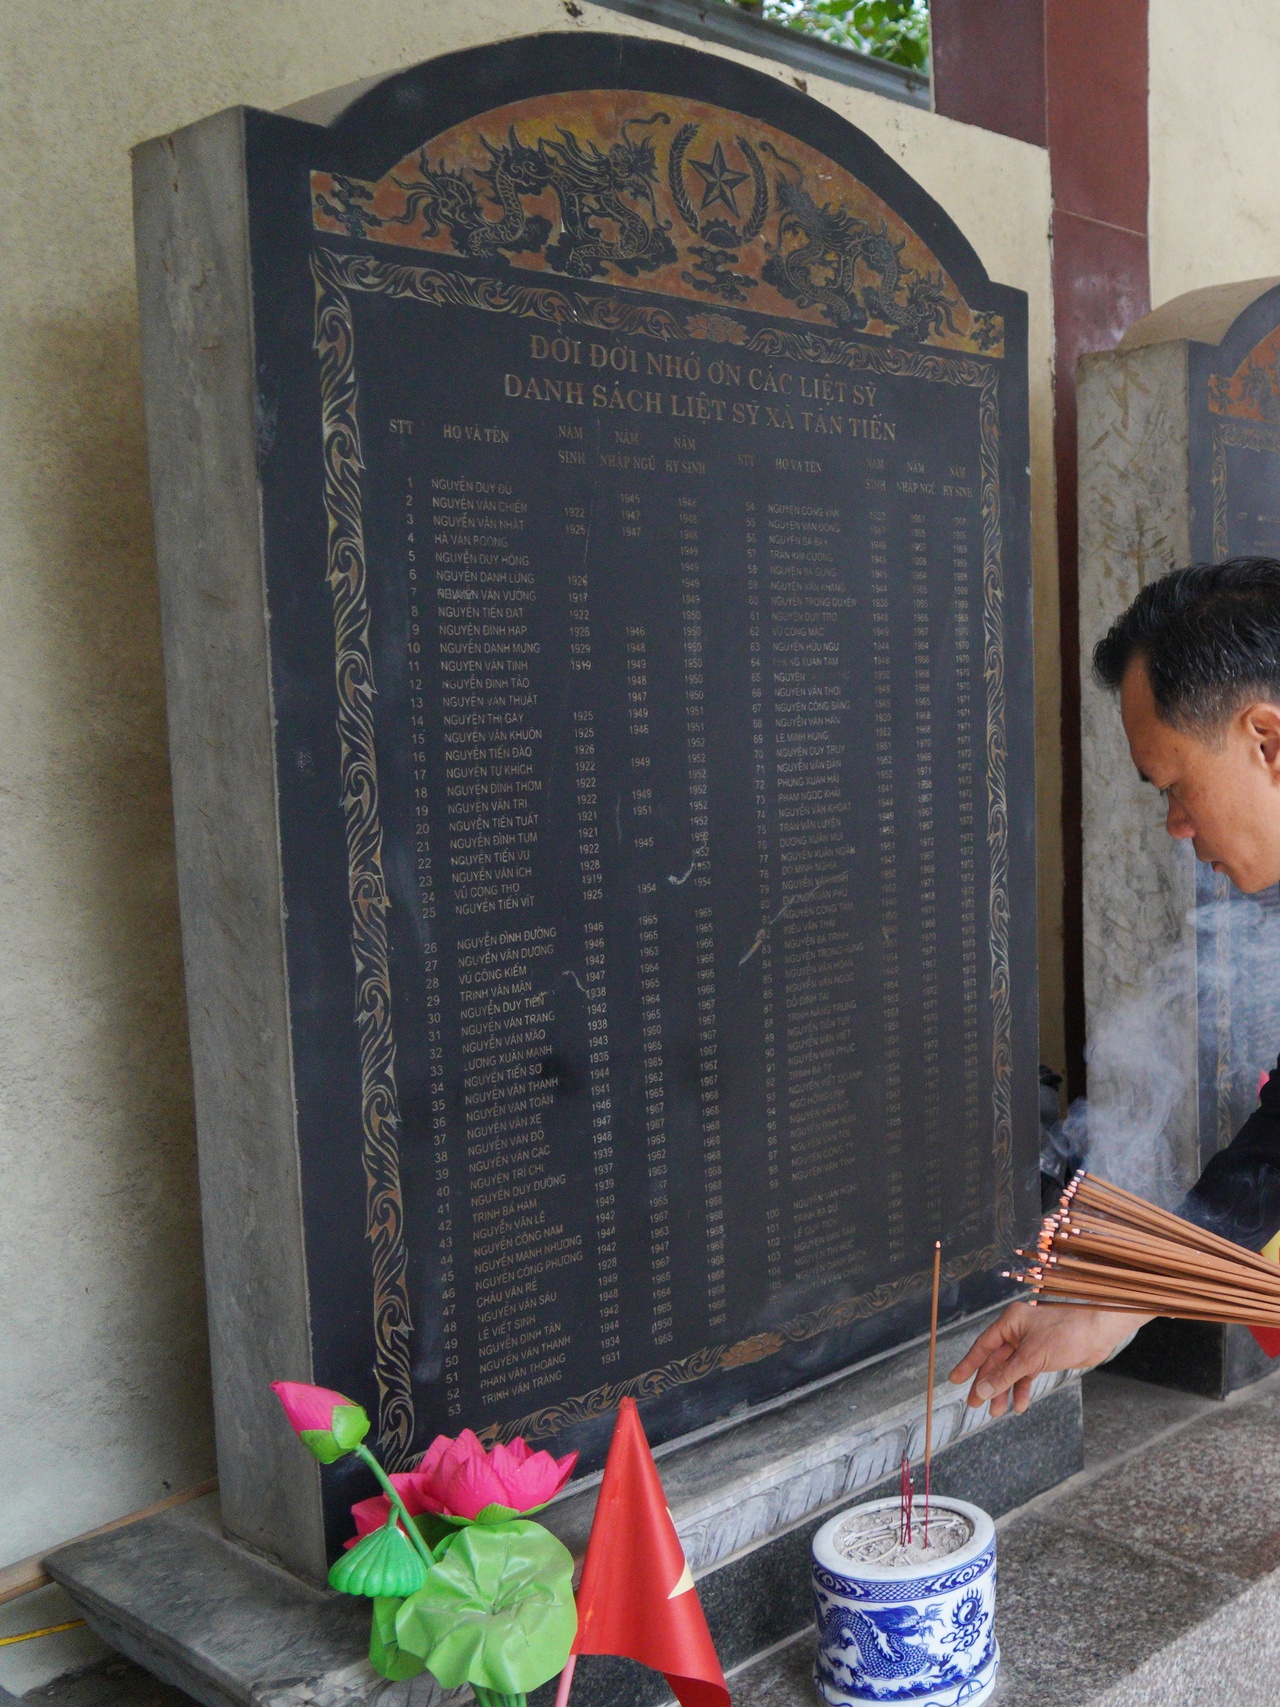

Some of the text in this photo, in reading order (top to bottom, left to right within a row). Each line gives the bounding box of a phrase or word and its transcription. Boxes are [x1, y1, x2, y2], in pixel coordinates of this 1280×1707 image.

[529, 330, 582, 365] ĐỜI
[590, 338, 638, 373] ĐỜI
[646, 350, 701, 381] NHỚ
[708, 360, 742, 387] ƠN
[748, 364, 794, 396] CÁC
[800, 373, 848, 406] LIỆT
[503, 373, 585, 406] DANH
[592, 380, 663, 415] SÁCH
[670, 391, 727, 424] LIỆT
[801, 408, 843, 435] TÂN
[849, 413, 898, 442] TIẾN
[389, 419, 509, 443] STT HỌ VÀ TÊN
[558, 422, 584, 441] NĂM
[615, 428, 640, 446] NĂM
[557, 450, 586, 465] SINH
[682, 460, 706, 475] SINH
[405, 495, 413, 507] 2
[432, 494, 474, 510] NGUYỄN
[564, 507, 585, 519] 1922
[621, 509, 641, 521] 1947
[412, 734, 425, 745] 15
[445, 728, 486, 743] NGUYỄN
[509, 728, 542, 741] KHUÔN
[574, 729, 594, 738] 1925
[630, 724, 649, 735] 1946
[413, 737, 706, 762] 16 NGUYỄN TIẾN ĐÀO 1926 1952
[415, 788, 428, 798] 18
[447, 779, 488, 796] NGUYỄN
[516, 780, 542, 792] THƠM
[576, 778, 596, 788] 1922
[416, 800, 708, 834] 20 NGUYỄN TIẾN TUẤT 1921 1951 1952
[419, 876, 433, 887] 23
[452, 865, 492, 884] NGUYỄN
[581, 860, 600, 871] 1928
[424, 908, 714, 954] 26 NGUYỄN ĐÌNH ĐƯỜNG 1946 1965 1965
[425, 978, 439, 989] 28
[474, 965, 502, 981] CÔNG
[585, 955, 605, 965] 1942
[640, 946, 659, 957] 1963
[432, 1100, 445, 1111] 35
[465, 1086, 505, 1106] NGUYỄN
[507, 1081, 525, 1095] VĂN
[528, 1077, 559, 1091] THANH
[590, 1067, 610, 1079] 1944
[440, 1255, 453, 1265] 44
[474, 1237, 513, 1258] NGUYỄN
[516, 1229, 540, 1247] CÔNG
[543, 1224, 564, 1237] NAM
[596, 1210, 615, 1222] 1942
[442, 1289, 455, 1299] 46
[475, 1268, 515, 1291] NGUYỄN
[516, 1261, 544, 1280] CÔNG
[545, 1250, 583, 1271] PHƯƠNG
[597, 1242, 617, 1254] 1942
[650, 1226, 669, 1237] 1963
[446, 1372, 459, 1384] 51
[480, 1355, 519, 1375] NGUYỄN
[541, 1335, 571, 1352] THANH
[600, 1320, 619, 1334] 1944
[653, 1302, 672, 1315] 1965
[448, 1405, 461, 1416] 53
[601, 1351, 621, 1365] 1931
